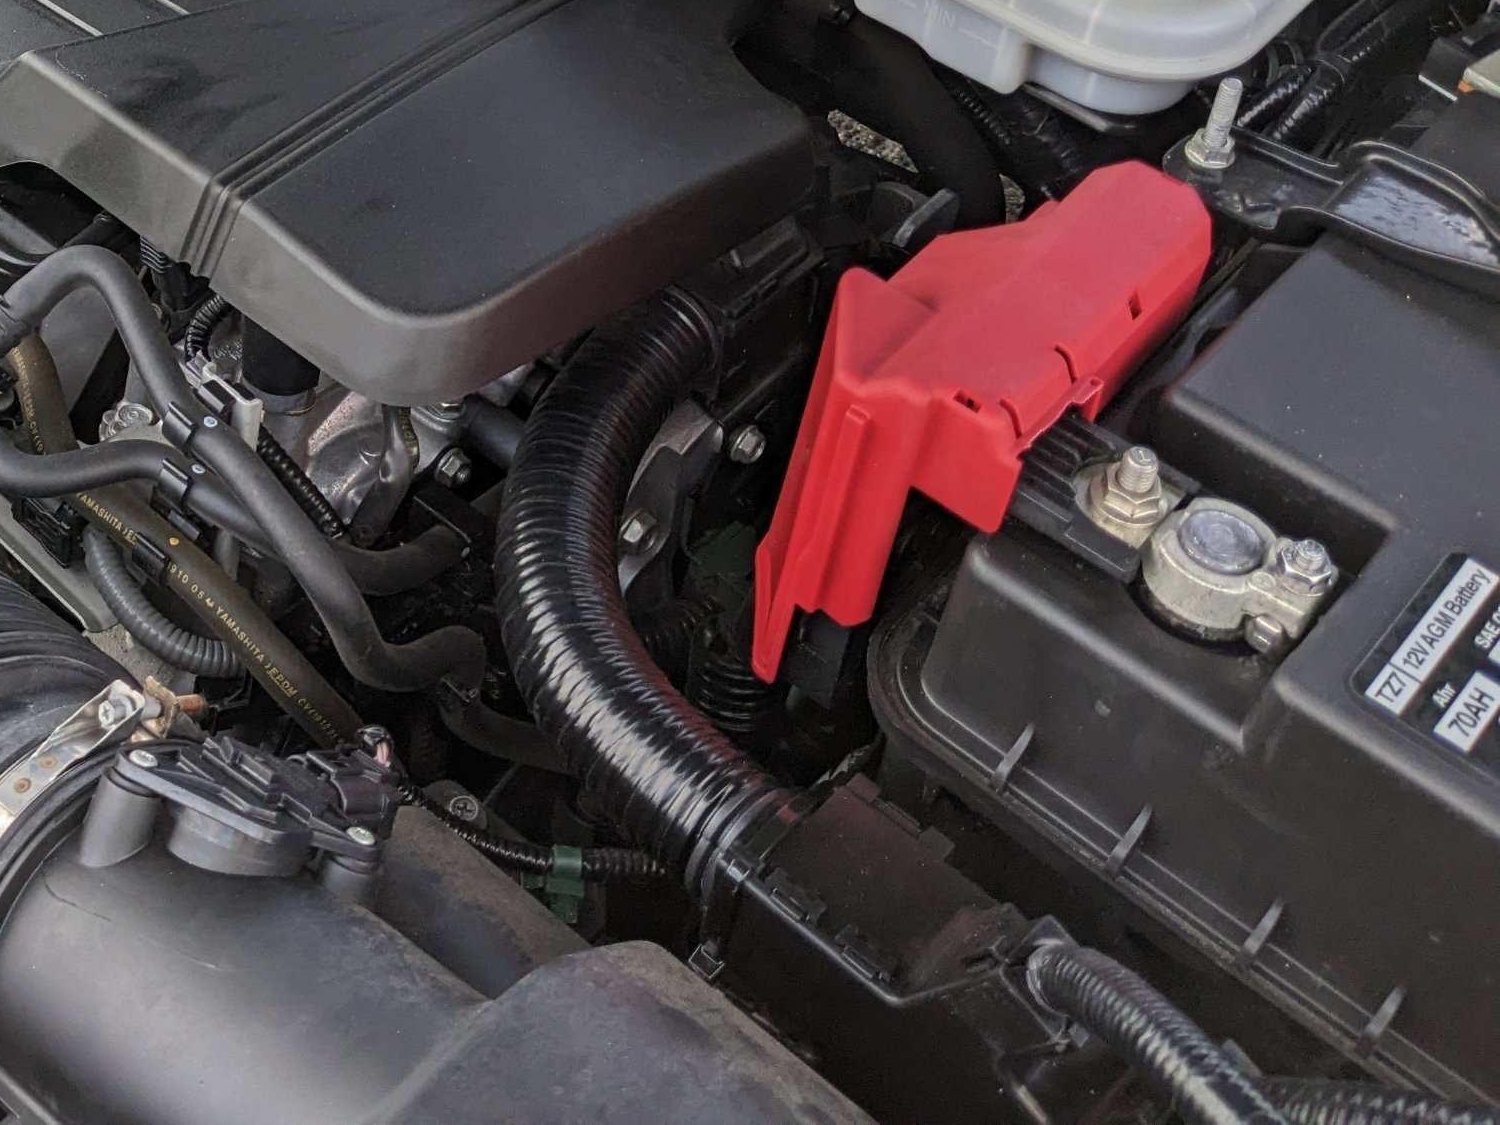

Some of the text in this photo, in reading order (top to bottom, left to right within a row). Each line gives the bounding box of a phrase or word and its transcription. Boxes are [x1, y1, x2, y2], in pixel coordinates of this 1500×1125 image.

[923, 0, 956, 27] MIN
[215, 605, 266, 663] YAMASHITA
[1374, 568, 1492, 704] TZ7 12V AGM Battery
[1474, 617, 1500, 650] SAE
[1448, 686, 1495, 737] 70AH
